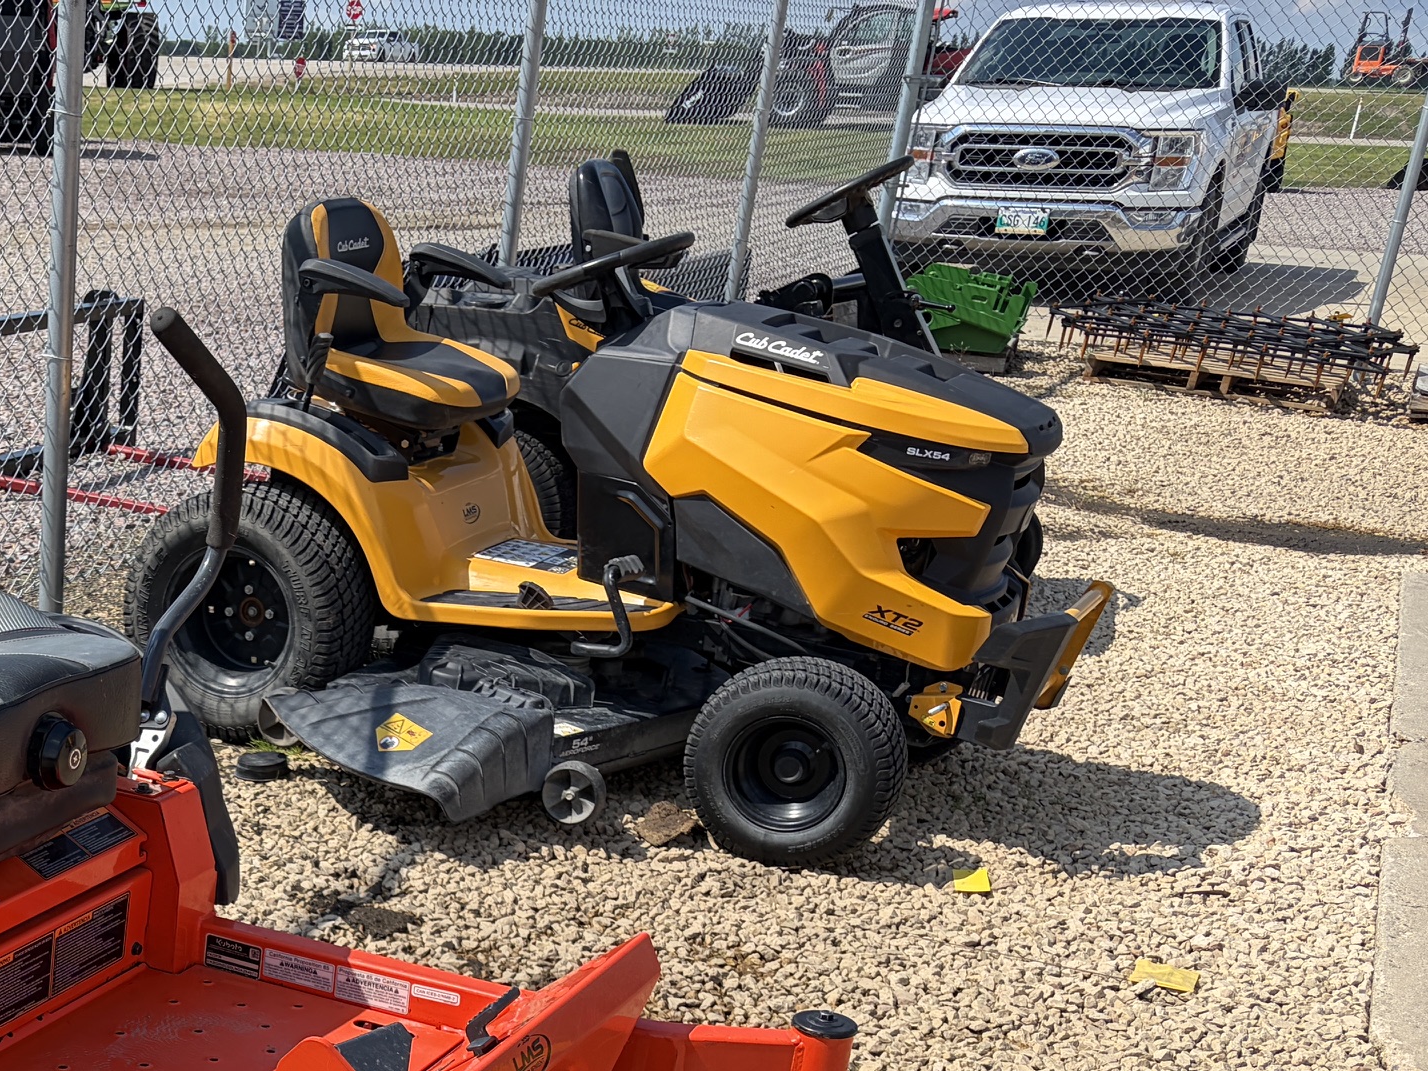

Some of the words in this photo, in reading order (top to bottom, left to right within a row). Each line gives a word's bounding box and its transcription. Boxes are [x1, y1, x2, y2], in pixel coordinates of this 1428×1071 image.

[1027, 215, 1046, 228] 146
[337, 240, 348, 252] Cub
[348, 236, 370, 251] Cadet
[735, 332, 769, 350] Cub
[767, 340, 824, 364] Cadet
[906, 446, 951, 461] SLX54
[135, 548, 169, 648] ARLISLE
[281, 560, 313, 623] TURF
[868, 604, 924, 632] XT2
[63, 914, 91, 932] ADVERTENCIA
[215, 938, 243, 953] Kubota
[268, 951, 293, 962] California
[294, 956, 322, 968] Proposition
[322, 964, 330, 972] 65
[284, 961, 313, 975] WARNING
[338, 967, 365, 980] Propuesta
[382, 977, 408, 989] California
[352, 977, 394, 994] ADVERTENCIA
